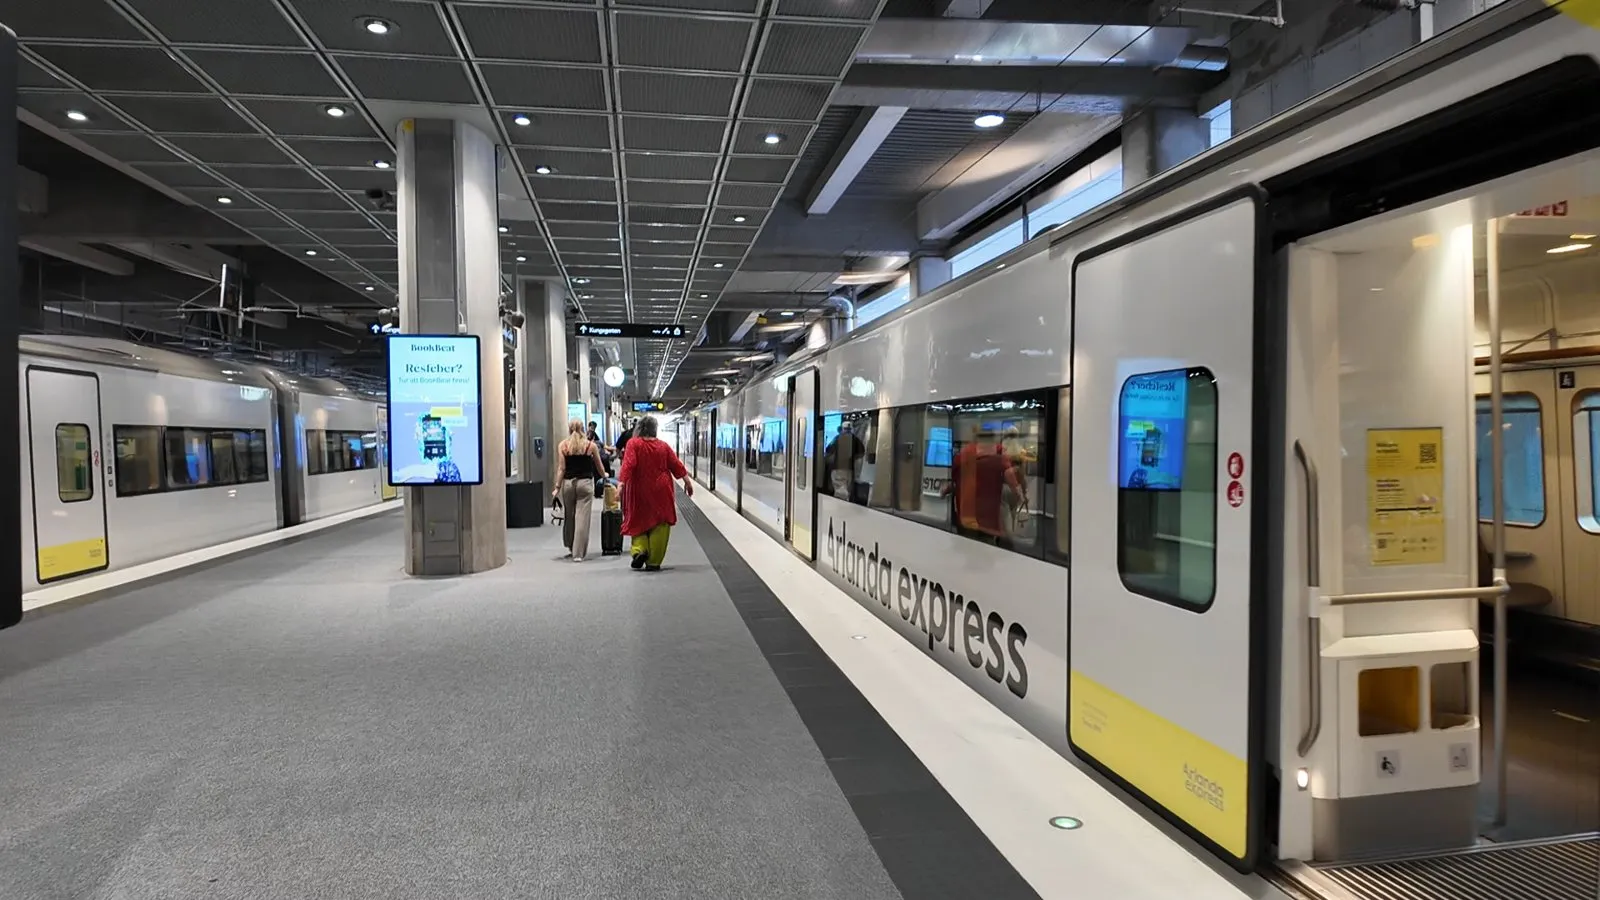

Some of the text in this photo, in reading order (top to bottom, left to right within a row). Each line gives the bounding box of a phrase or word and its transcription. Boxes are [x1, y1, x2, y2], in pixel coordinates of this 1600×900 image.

[411, 344, 455, 352] BookBeat
[827, 516, 1028, 700] Arlanda express
